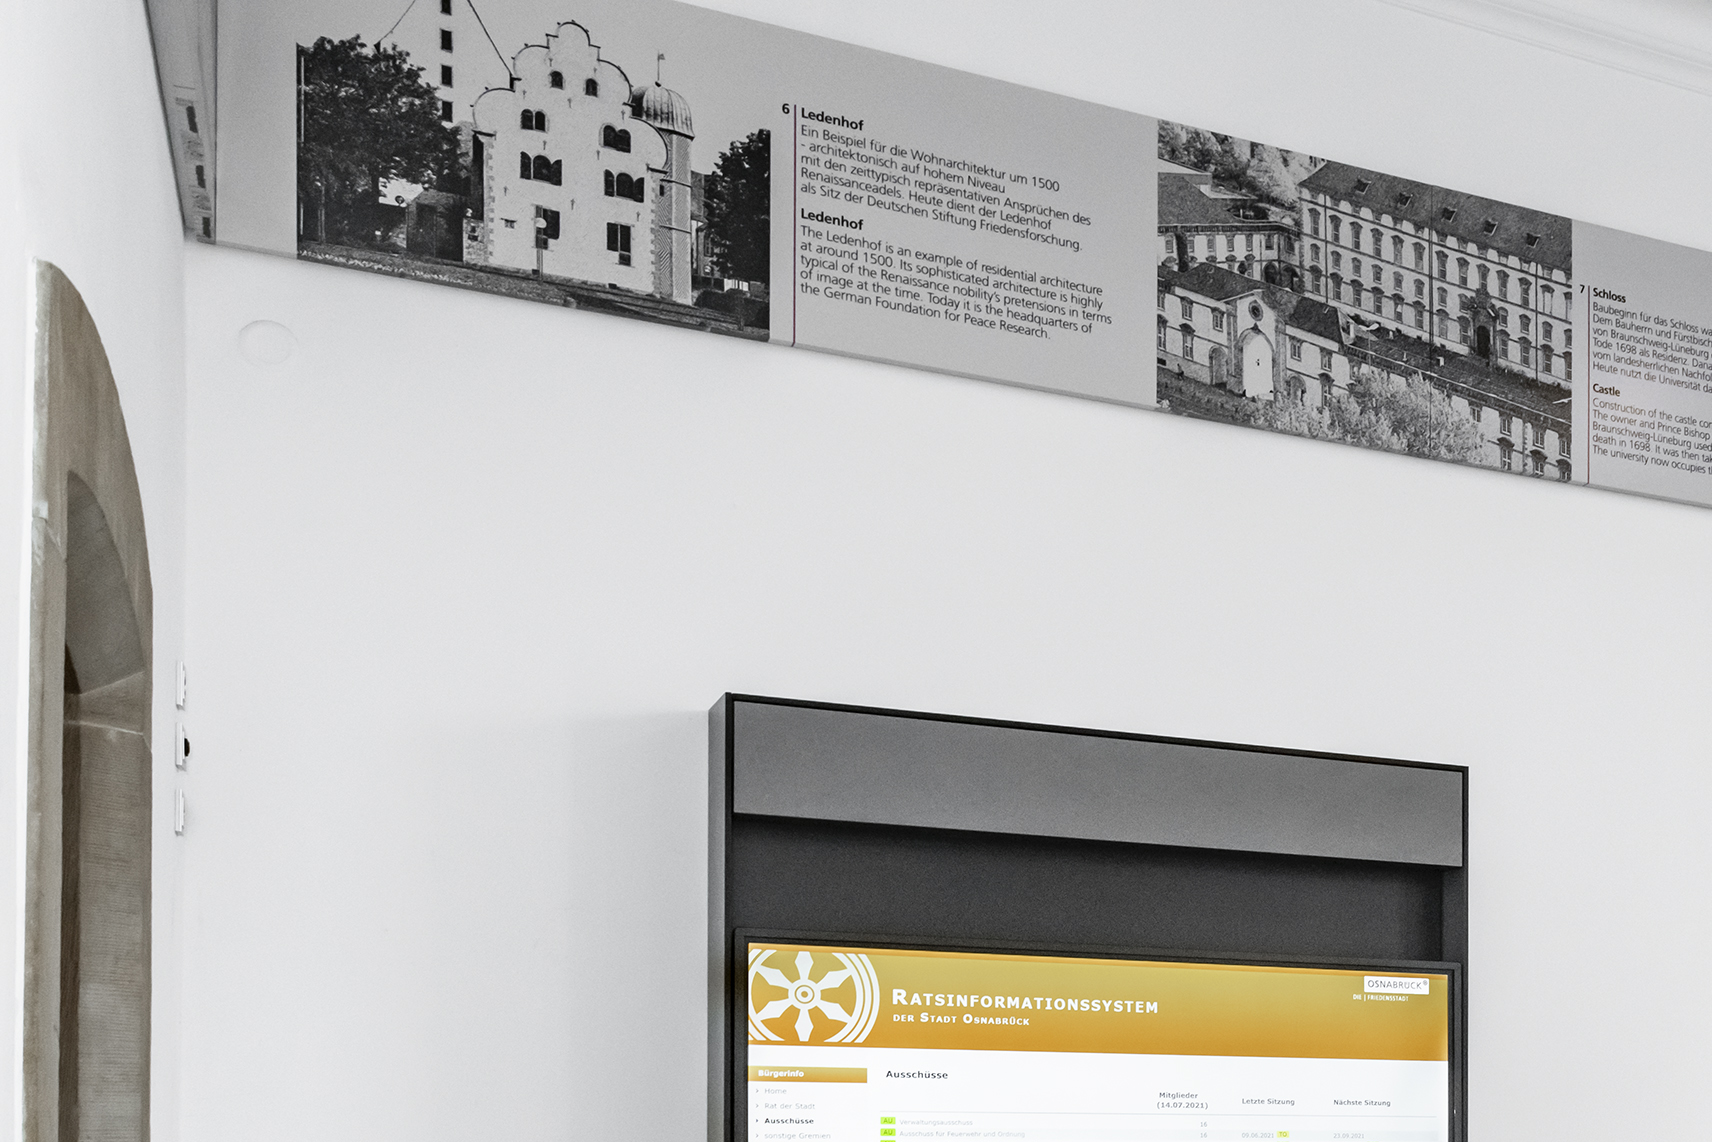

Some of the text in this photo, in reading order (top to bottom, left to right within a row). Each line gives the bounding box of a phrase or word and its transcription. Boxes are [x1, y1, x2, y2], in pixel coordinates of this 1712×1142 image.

[782, 103, 791, 115] 6
[800, 107, 864, 130] Ledenhof
[800, 124, 1060, 192] Ein Beispiel für die Wohnarchitektur um 1500
[808, 142, 898, 170] architektonisch
[900, 162, 920, 175] auf
[923, 164, 964, 184] hohem
[966, 174, 1005, 193] Niveau
[800, 154, 1091, 225] mit den zeittypisch repräsentativen Ansprüchen des
[800, 166, 1051, 230] Renaissanceadels. Heute dient der Ledenhof
[799, 182, 1083, 251] als Sitz der Deutschen Stiftung Friedensforschung.
[800, 208, 863, 231] Ledenhof
[802, 225, 1103, 296] The Ledenhof is an example of residential architecture
[799, 240, 1103, 311] at around 1500. Its sophisticated architecture is highly
[799, 253, 838, 271] typical
[840, 262, 854, 274] of
[857, 264, 877, 279] the
[880, 268, 950, 293] Renaissance
[1002, 295, 1066, 315] pretensions
[1068, 305, 1079, 318] in
[1081, 308, 1112, 324] terms
[1579, 284, 1585, 294] 7
[1592, 288, 1626, 304] Schloss
[799, 268, 1092, 333] of image at the time. Today it is the headquarters of
[799, 282, 1051, 339] the German Foundation for Peace Research.
[1592, 302, 1638, 320] Baubeginn
[1639, 312, 1651, 324] für
[1653, 315, 1668, 327] das
[1669, 319, 1699, 334] Schloss
[1592, 383, 1620, 397] Castle
[885, 1070, 949, 1080] Ausschüsse
[1156, 1101, 1209, 1110] (14.07.2021)
[1159, 1091, 1199, 1100] Mitglieder
[1267, 1098, 1295, 1107] Sitzung
[1364, 1100, 1391, 1108] Sitzung
[764, 1117, 815, 1125] Ausschüsse
[764, 1132, 831, 1140] sonstige Gremien
